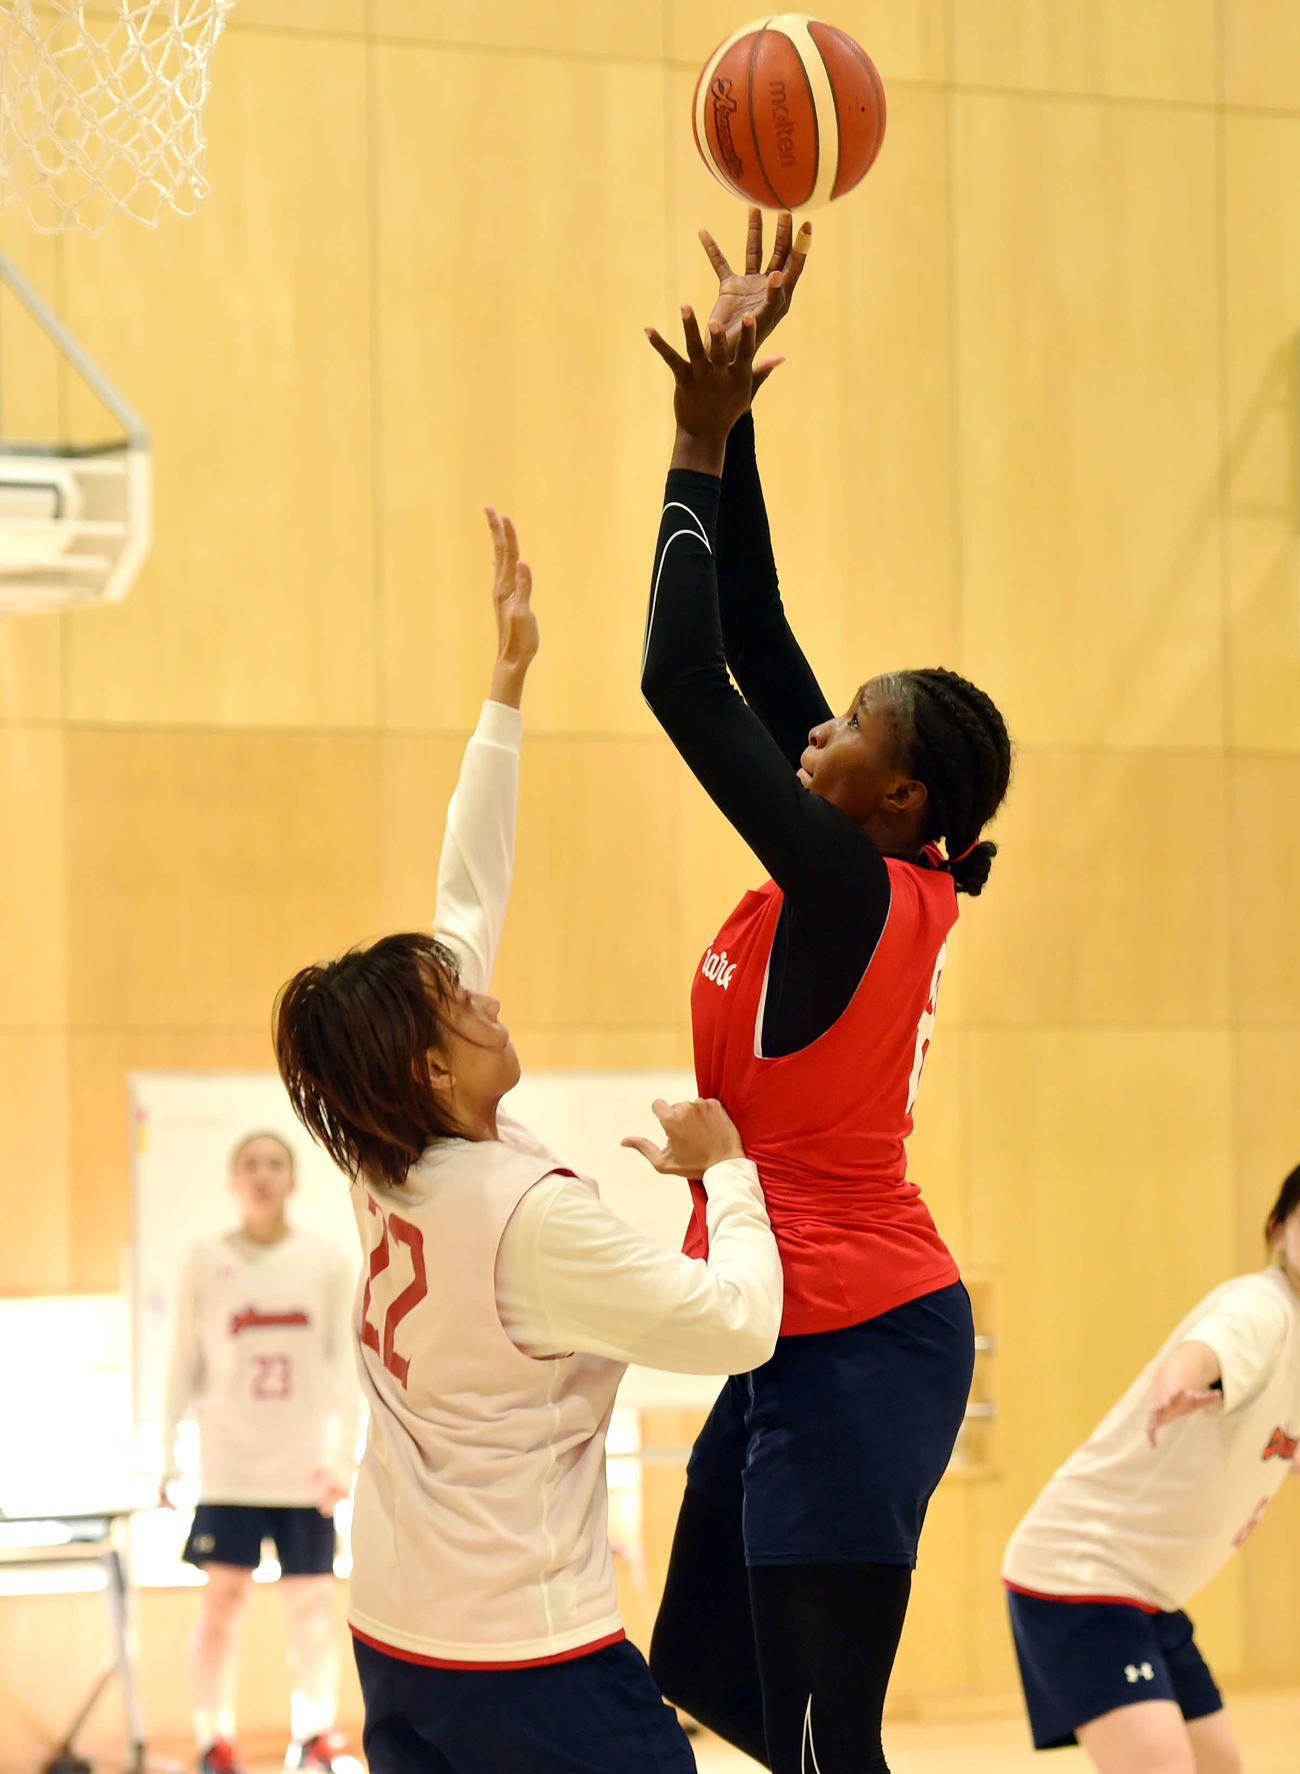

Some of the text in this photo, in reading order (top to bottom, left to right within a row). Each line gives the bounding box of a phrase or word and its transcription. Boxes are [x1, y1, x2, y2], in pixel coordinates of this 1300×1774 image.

[770, 81, 796, 168] molten
[360, 1191, 428, 1390] 22
[252, 1354, 292, 1401] 23
